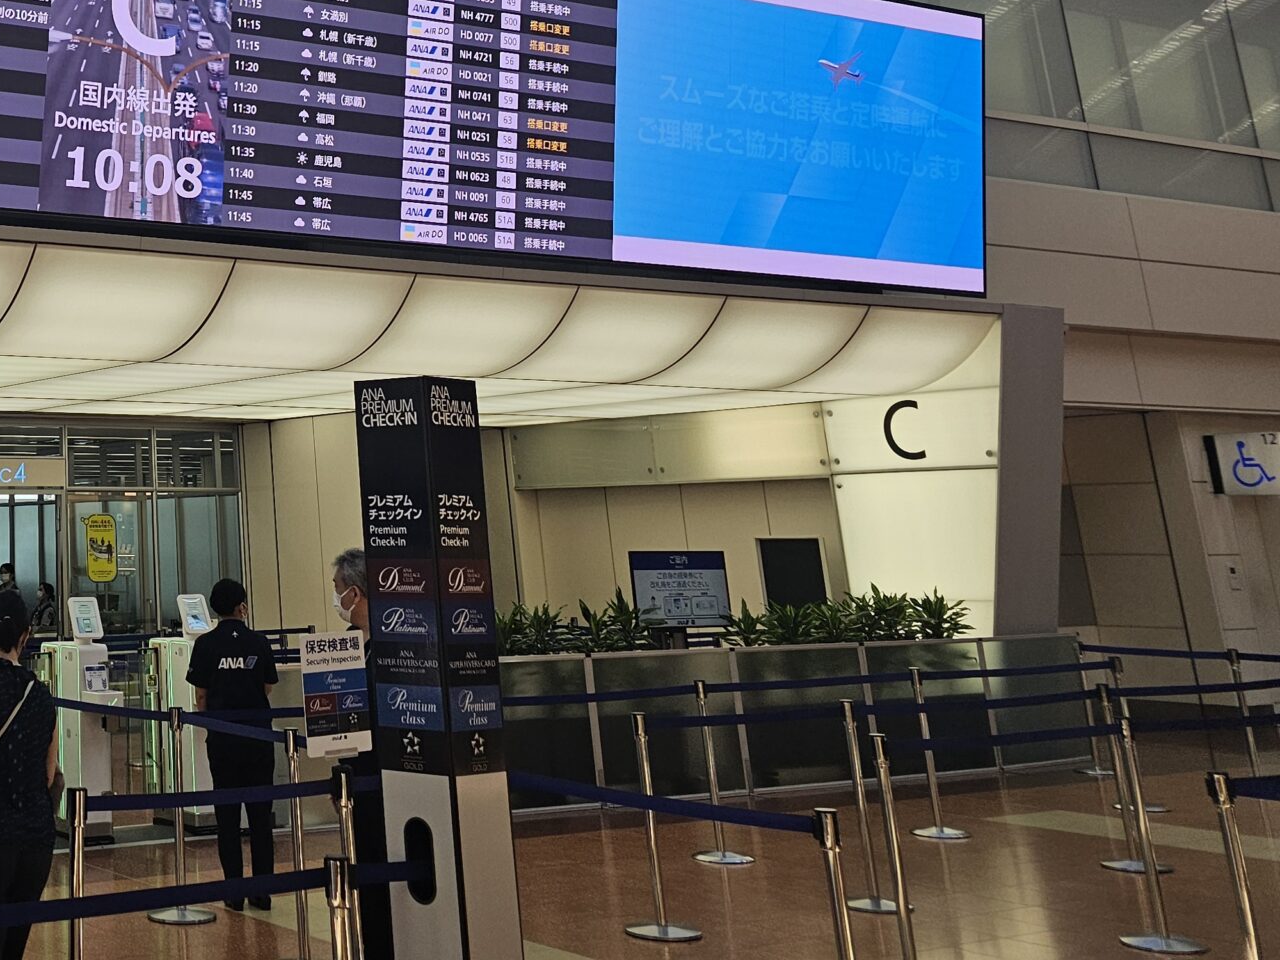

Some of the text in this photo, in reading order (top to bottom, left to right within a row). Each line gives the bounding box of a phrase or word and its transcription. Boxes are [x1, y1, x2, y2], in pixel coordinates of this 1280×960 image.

[461, 10, 473, 20] NH
[474, 12, 494, 23] 4777
[78, 80, 197, 119] 国内線出発
[55, 111, 216, 144] Domestic Departures
[66, 146, 202, 199] 10:08
[228, 189, 253, 201] 11:45
[454, 211, 467, 221] NH
[361, 388, 385, 401] ANA
[431, 385, 450, 399] ANA
[361, 399, 414, 414] PREMIUM
[431, 398, 472, 414] PREMIUM
[362, 411, 418, 428] CHECK-IN
[431, 411, 476, 428] CHECK-IN
[883, 399, 927, 460] C
[1261, 433, 1277, 445] 12
[368, 495, 413, 507] プレミアム
[438, 494, 473, 507] プレミアム
[369, 508, 422, 520] チェックイン
[439, 508, 480, 520] チェックイン
[370, 525, 407, 535] Premium
[440, 524, 470, 535] Premium
[370, 537, 407, 547] Check-In
[441, 537, 469, 547] Check-In
[379, 567, 426, 593] Diamond
[381, 607, 428, 634] Platinum
[305, 636, 360, 655] 保安検査場
[218, 656, 244, 670] ANA
[306, 655, 361, 666] Security Inspection
[388, 687, 437, 713] Premium
[401, 712, 426, 725] class
